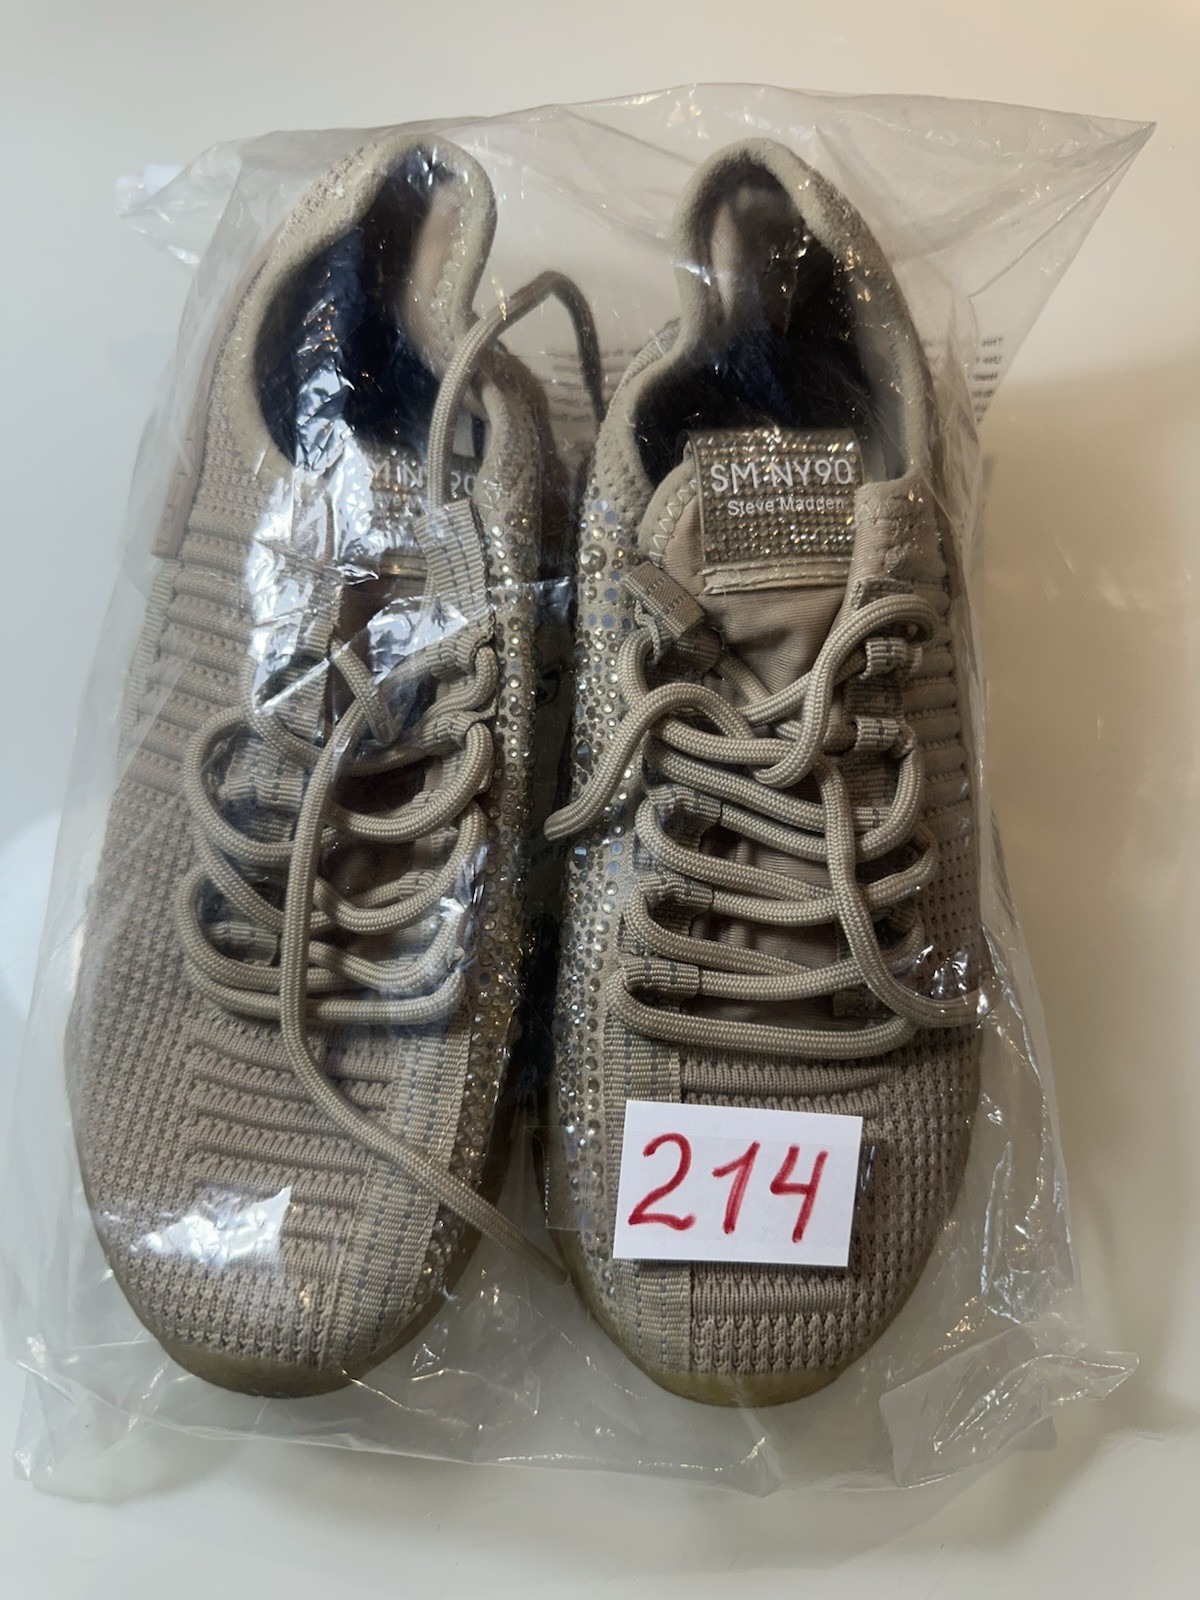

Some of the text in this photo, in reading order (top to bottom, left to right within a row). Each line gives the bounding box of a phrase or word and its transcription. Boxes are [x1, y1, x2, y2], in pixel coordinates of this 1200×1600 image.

[728, 496, 845, 516] Steve Madden
[628, 1132, 829, 1243] 214
